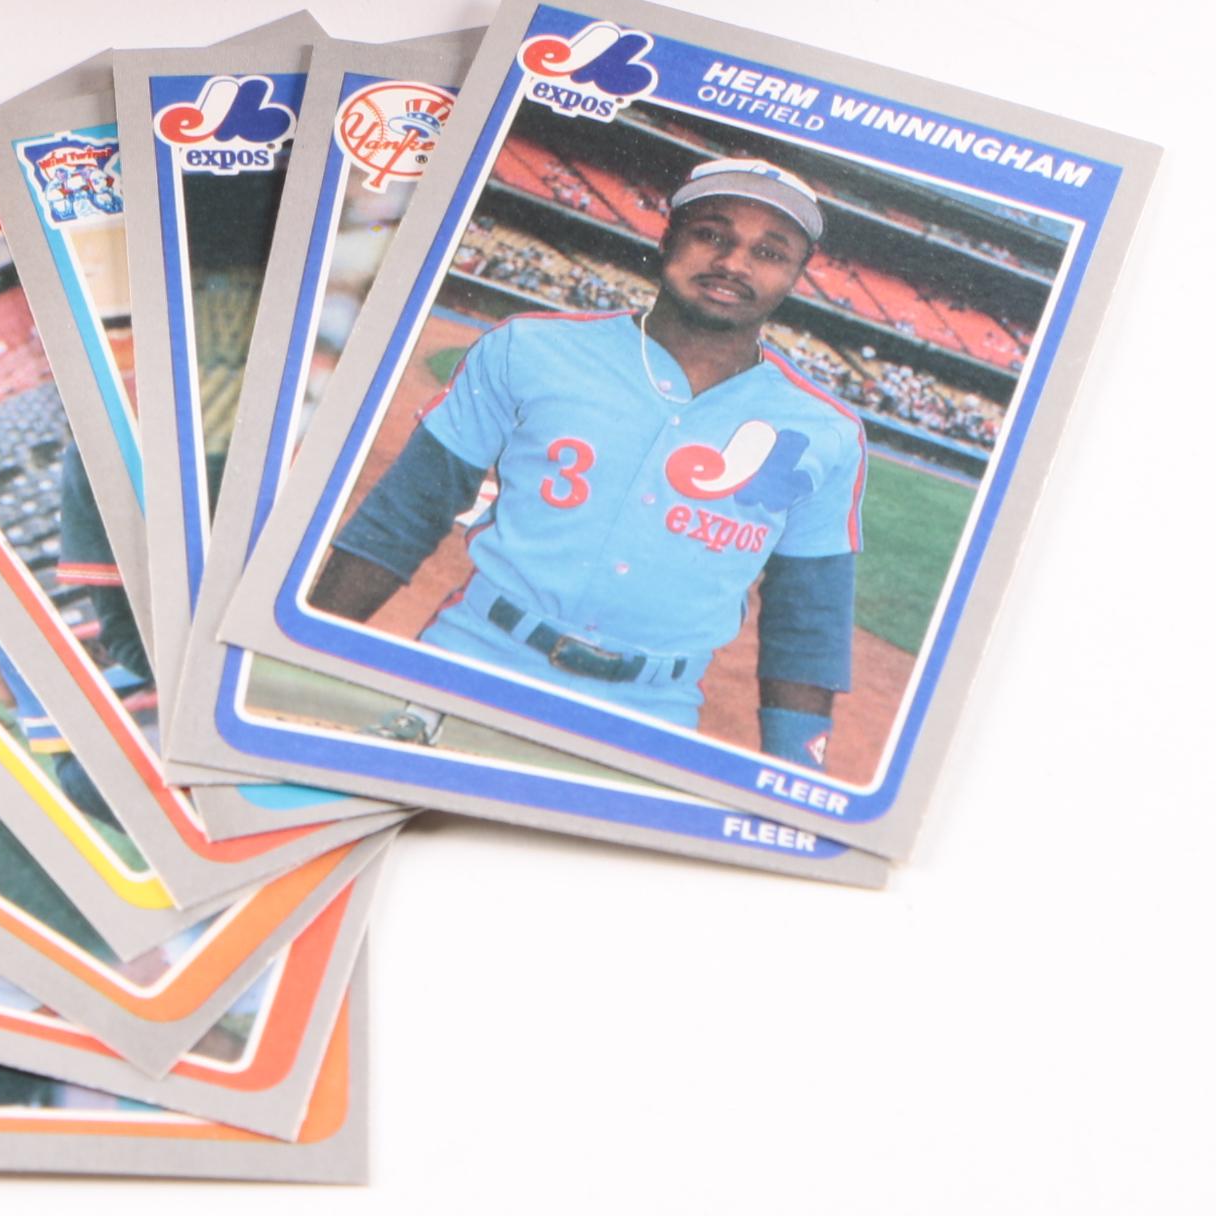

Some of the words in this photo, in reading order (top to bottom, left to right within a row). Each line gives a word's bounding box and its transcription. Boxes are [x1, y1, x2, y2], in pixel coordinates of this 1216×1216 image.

[533, 80, 615, 118] expos
[697, 85, 826, 132] OUTFIELD
[702, 61, 820, 110] HERM
[829, 95, 1093, 189] WINNINGHAM
[186, 148, 270, 169] expos
[540, 437, 596, 510] 3
[665, 505, 770, 553] expos
[756, 768, 849, 815] FLEER
[722, 816, 817, 852] FLEER
